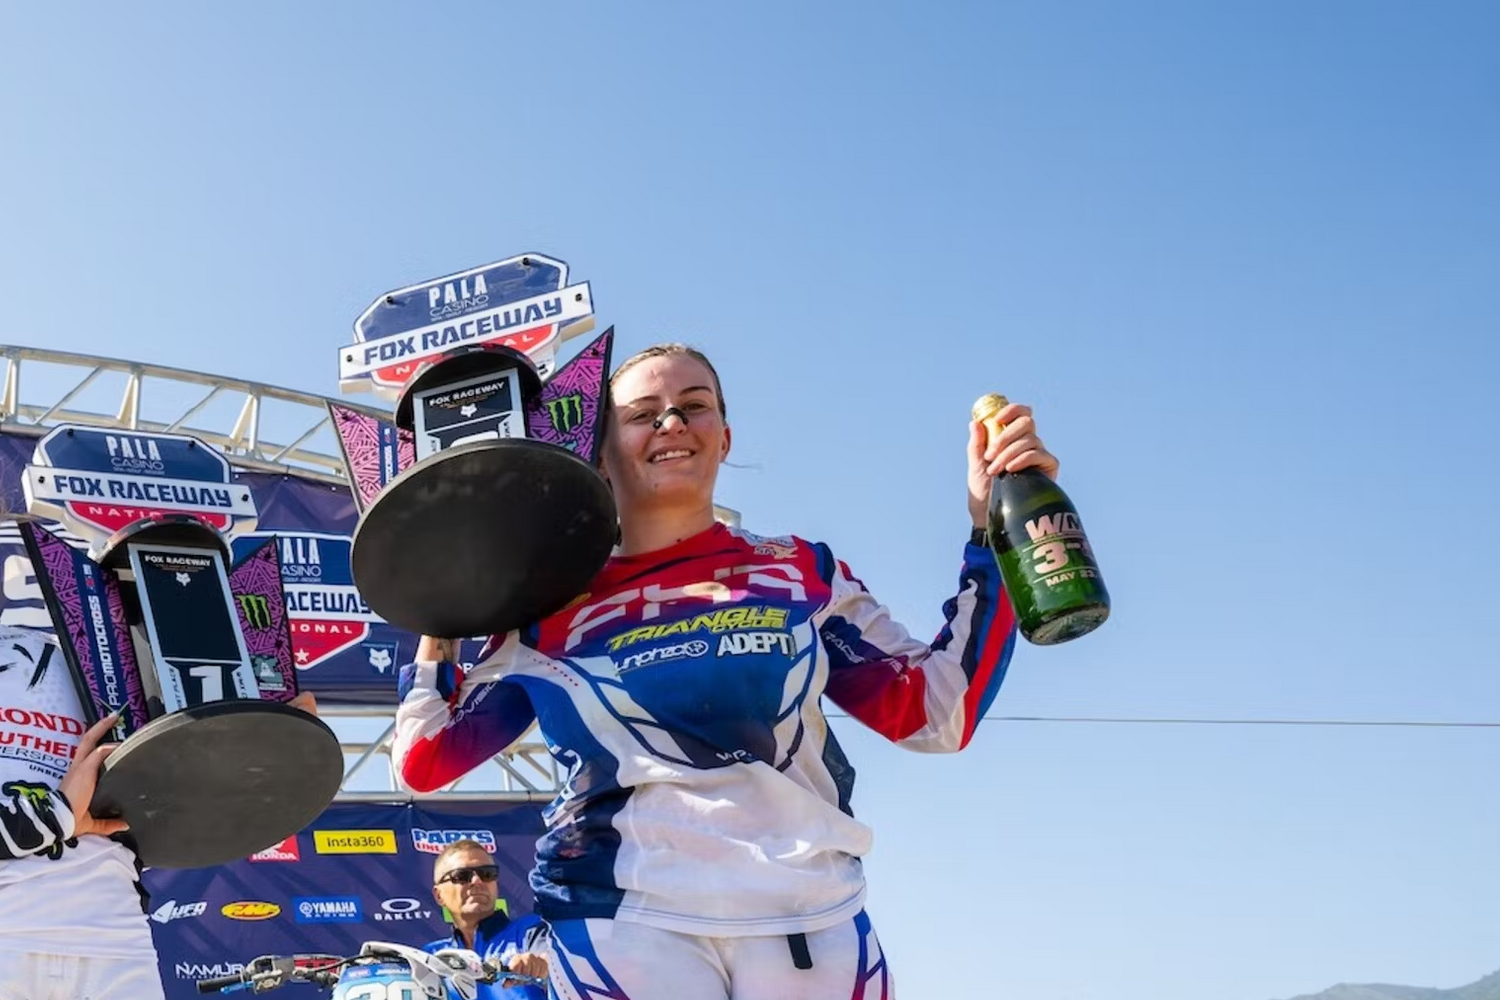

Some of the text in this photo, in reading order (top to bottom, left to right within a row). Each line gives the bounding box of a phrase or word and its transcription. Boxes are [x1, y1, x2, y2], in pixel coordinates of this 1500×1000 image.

[428, 274, 488, 308] PALA
[429, 294, 490, 318] CASINO
[364, 335, 416, 366] FOX
[422, 296, 563, 350] RACEWAY
[429, 382, 505, 407] FOX RACEWAY
[106, 436, 162, 461] PALA
[111, 457, 165, 472] CASINO
[54, 474, 233, 508] FOX RACEWAY
[145, 555, 212, 567] FOX RACEWAY
[283, 538, 321, 564] ALA
[1045, 571, 1075, 587] MAY
[286, 590, 373, 615] ACEWAY
[291, 622, 353, 635] IONAL
[607, 606, 787, 652] TRIANGLE
[716, 632, 791, 657] ADEPT
[190, 666, 223, 702] 1
[327, 835, 385, 848] insta360
[412, 828, 494, 847] PARTS
[251, 851, 299, 862] HONDA
[312, 902, 358, 914] YAMAHA
[374, 910, 433, 922] OAKLEY
[175, 961, 244, 976] NAMUR
